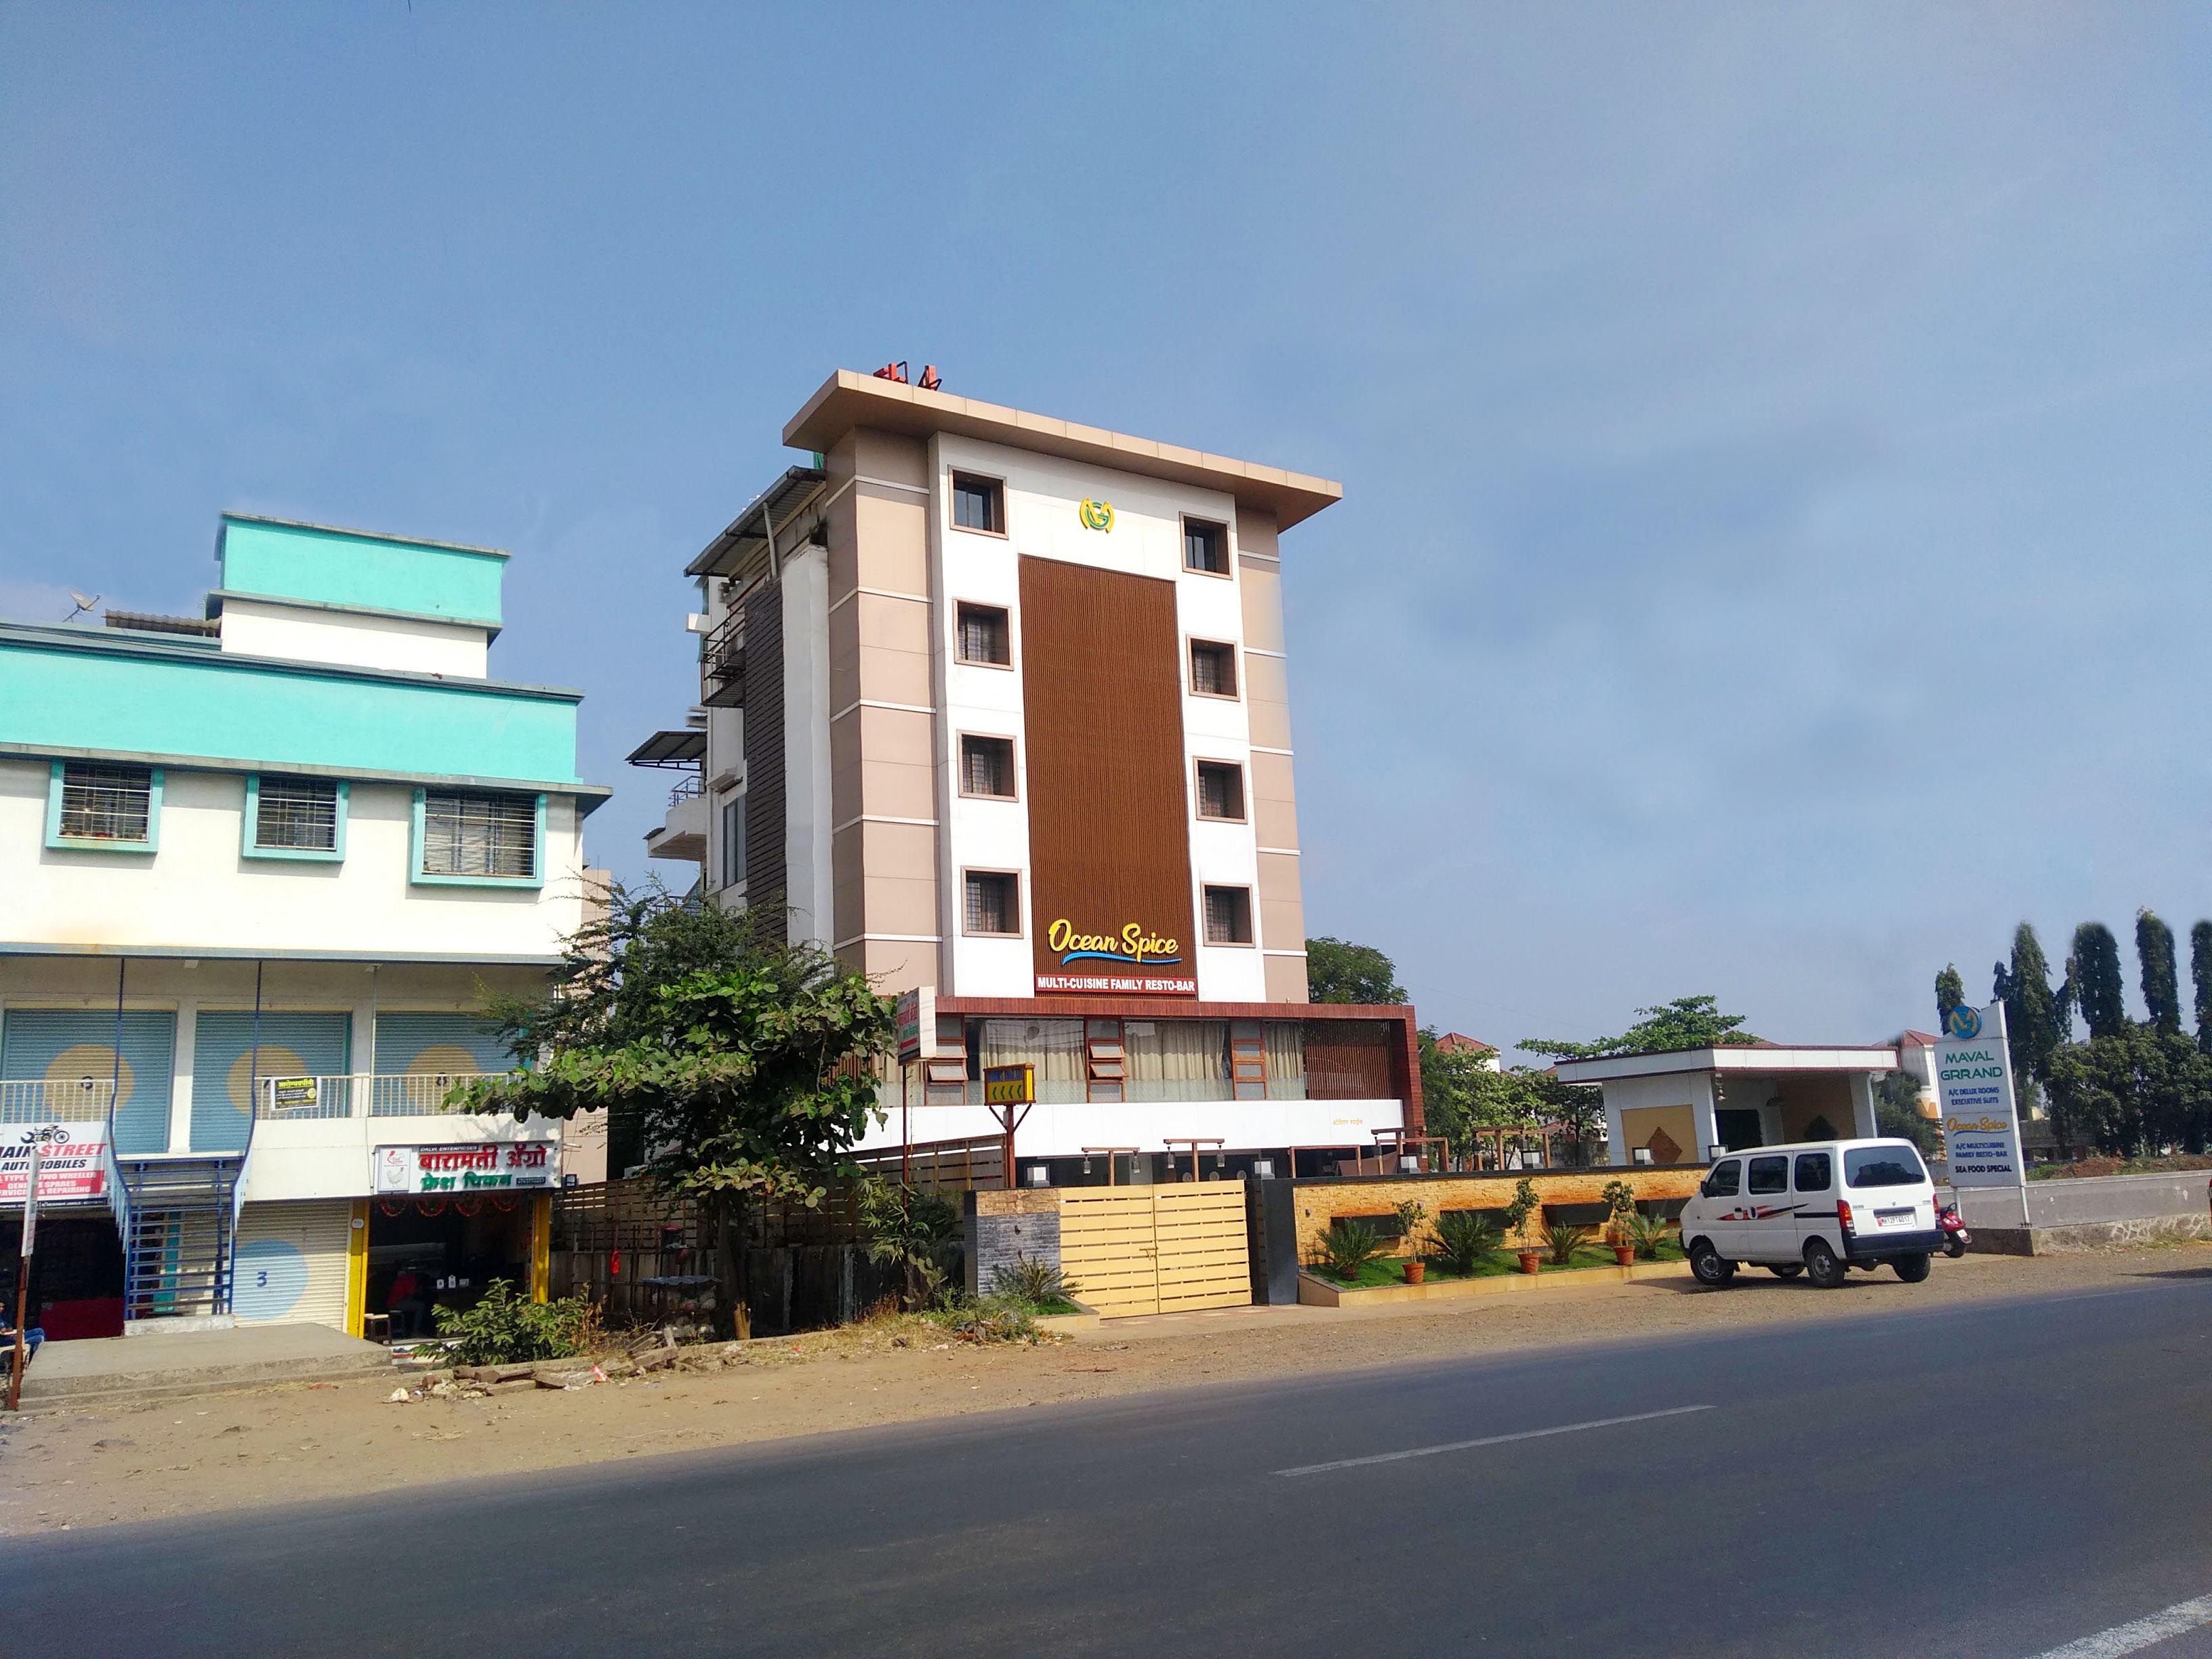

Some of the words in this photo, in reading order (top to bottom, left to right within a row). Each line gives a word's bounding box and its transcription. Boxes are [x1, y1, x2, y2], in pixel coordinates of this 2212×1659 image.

[1048, 919, 1118, 951] Ocean
[1122, 922, 1179, 962] Spice
[1038, 977, 1109, 989] MULTI-CUISINE
[1111, 978, 1143, 991] FAMILY
[1145, 979, 1195, 992] RESTO-BAR
[1945, 1050, 1994, 1064] MAVAL
[1940, 1067, 2003, 1081] GRRAND
[1948, 1088, 1959, 1097] A/C
[1959, 1087, 1978, 1095] DELUX
[1952, 1097, 1982, 1105] EXECUTIVE
[1947, 1118, 1978, 1132] Ocean
[1980, 1117, 2007, 1132] Spice
[40, 1143, 107, 1157] STREET
[419, 1144, 499, 1170] बारामती
[1968, 1165, 1986, 1173] FOOD
[1986, 1164, 2012, 1172] SPECIAL
[422, 1172, 457, 1191] फ्रेश
[464, 1171, 512, 1188] चिकन
[47, 1186, 91, 1195] REPAIRING
[257, 1271, 267, 1287] 3
